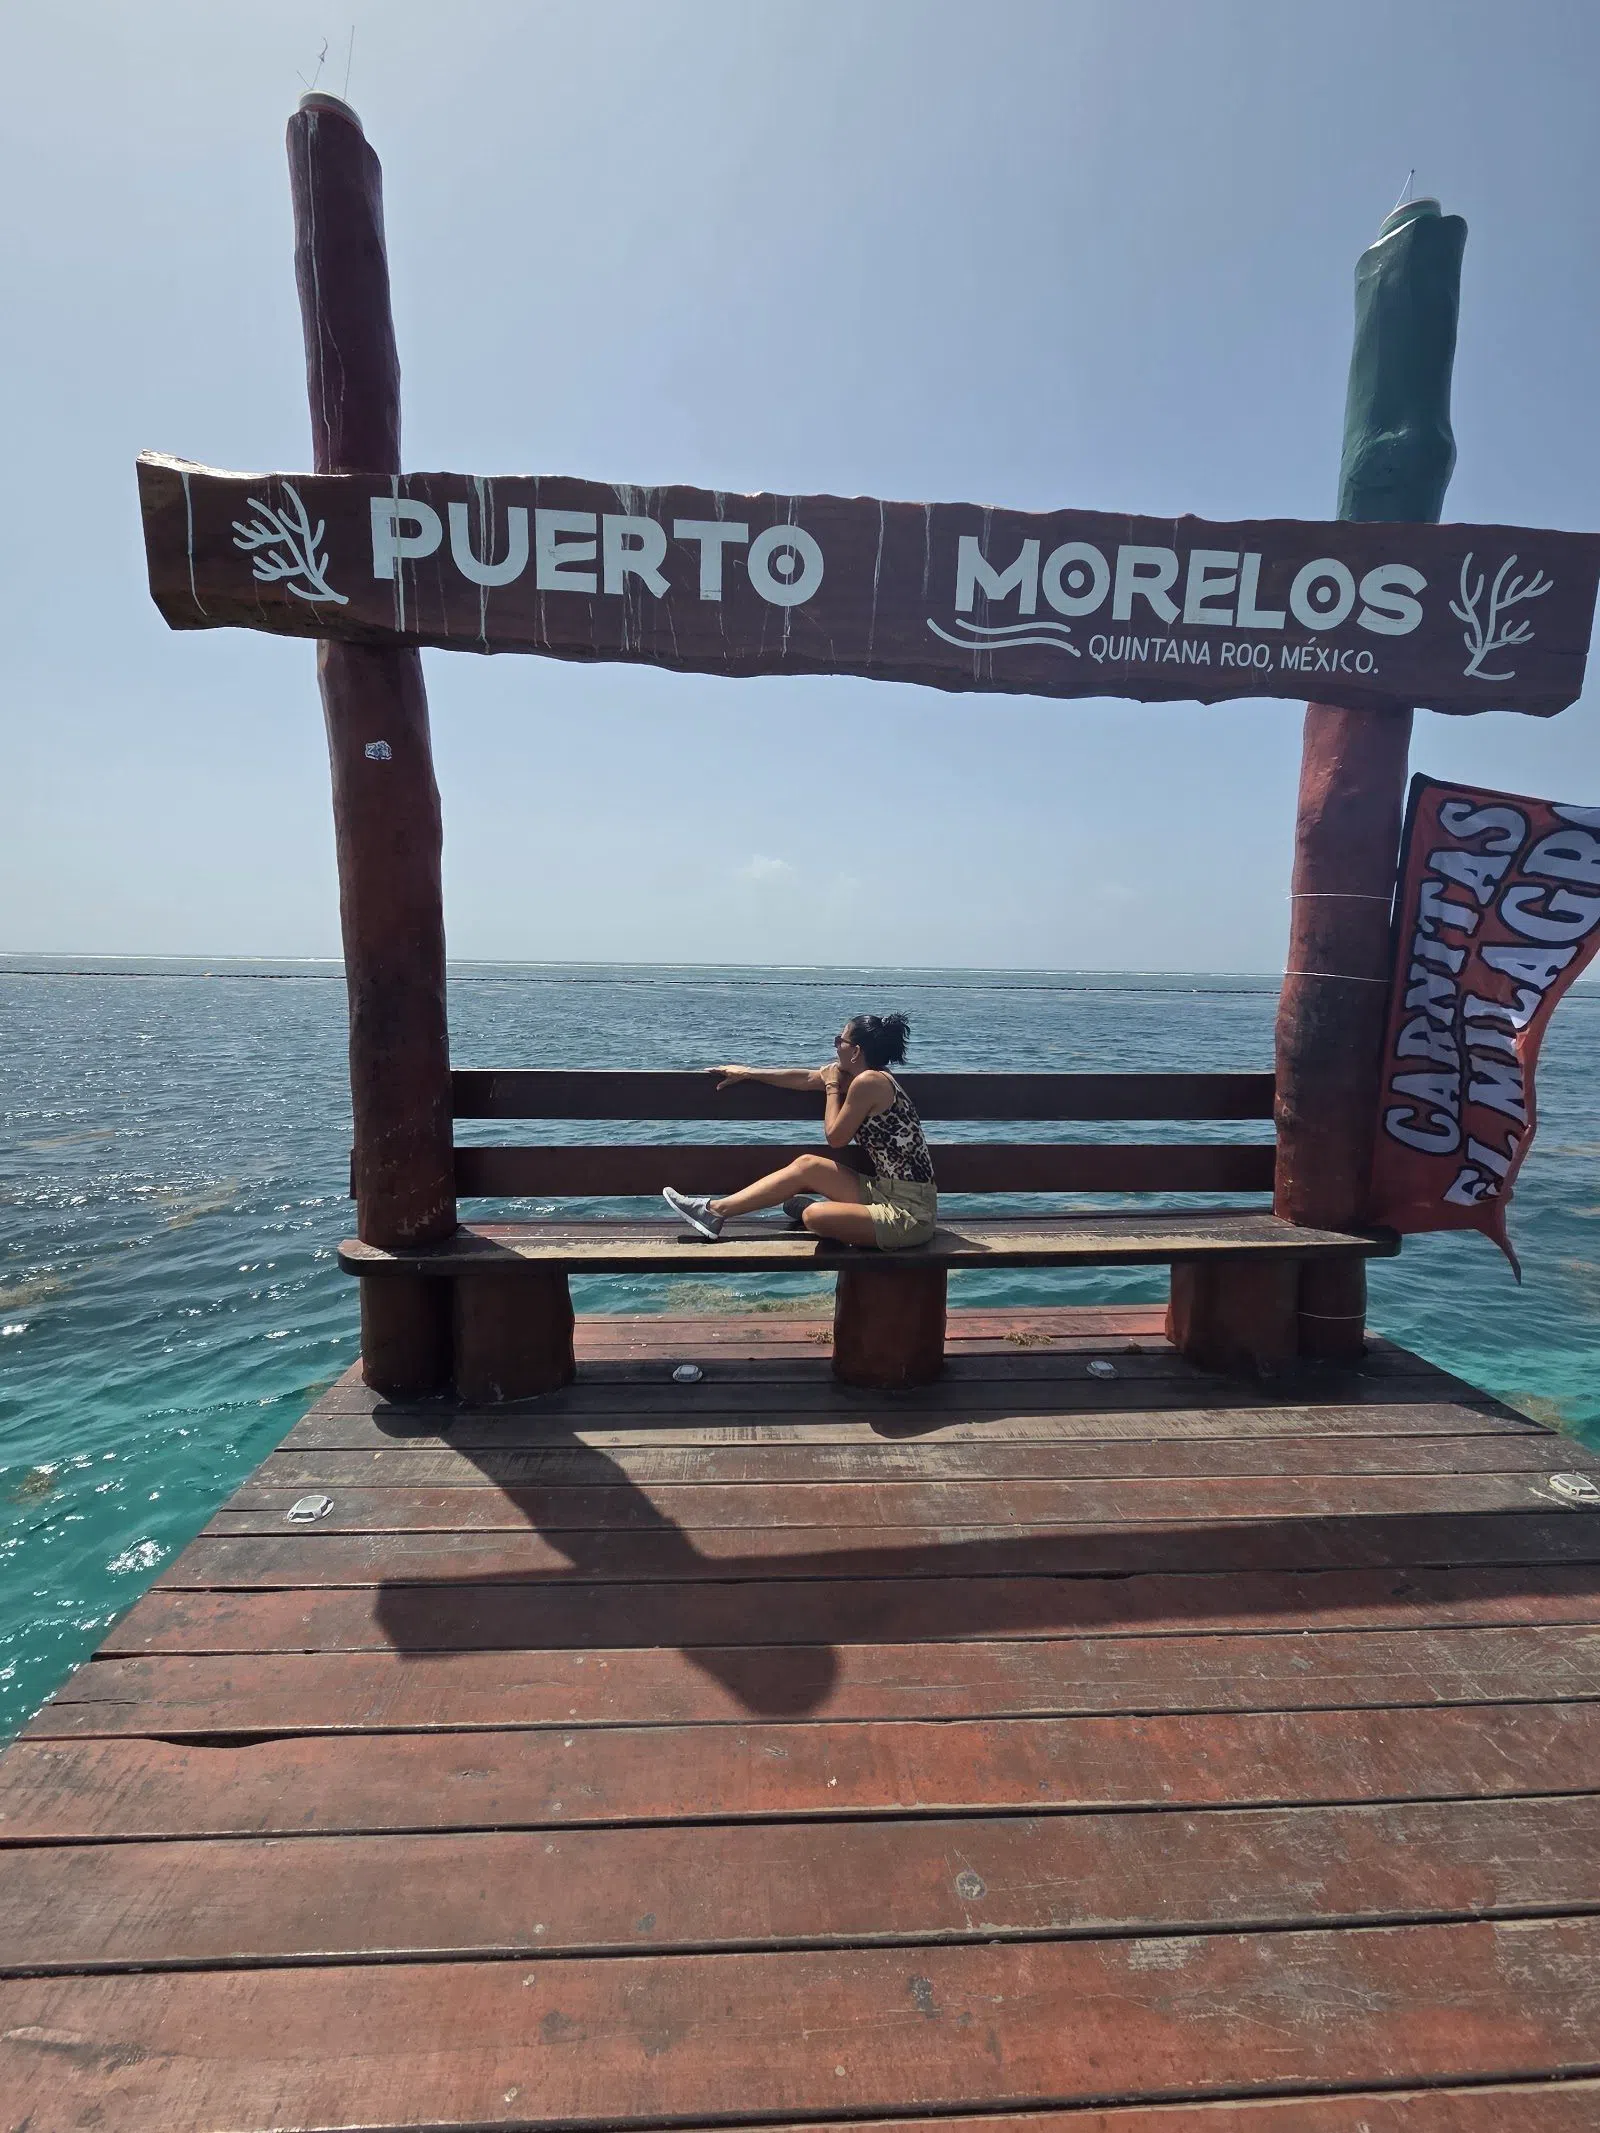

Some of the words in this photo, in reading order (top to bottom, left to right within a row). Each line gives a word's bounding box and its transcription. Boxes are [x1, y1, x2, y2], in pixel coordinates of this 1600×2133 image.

[370, 496, 825, 607] PUERTO
[955, 534, 1428, 636] MORELOS
[1088, 633, 1211, 666] QUINTANA
[1220, 641, 1274, 673] ROO,
[1280, 636, 1380, 675] MÉXICO.
[1385, 801, 1526, 1155] CARNITAS
[1442, 1135, 1519, 1207] EL
